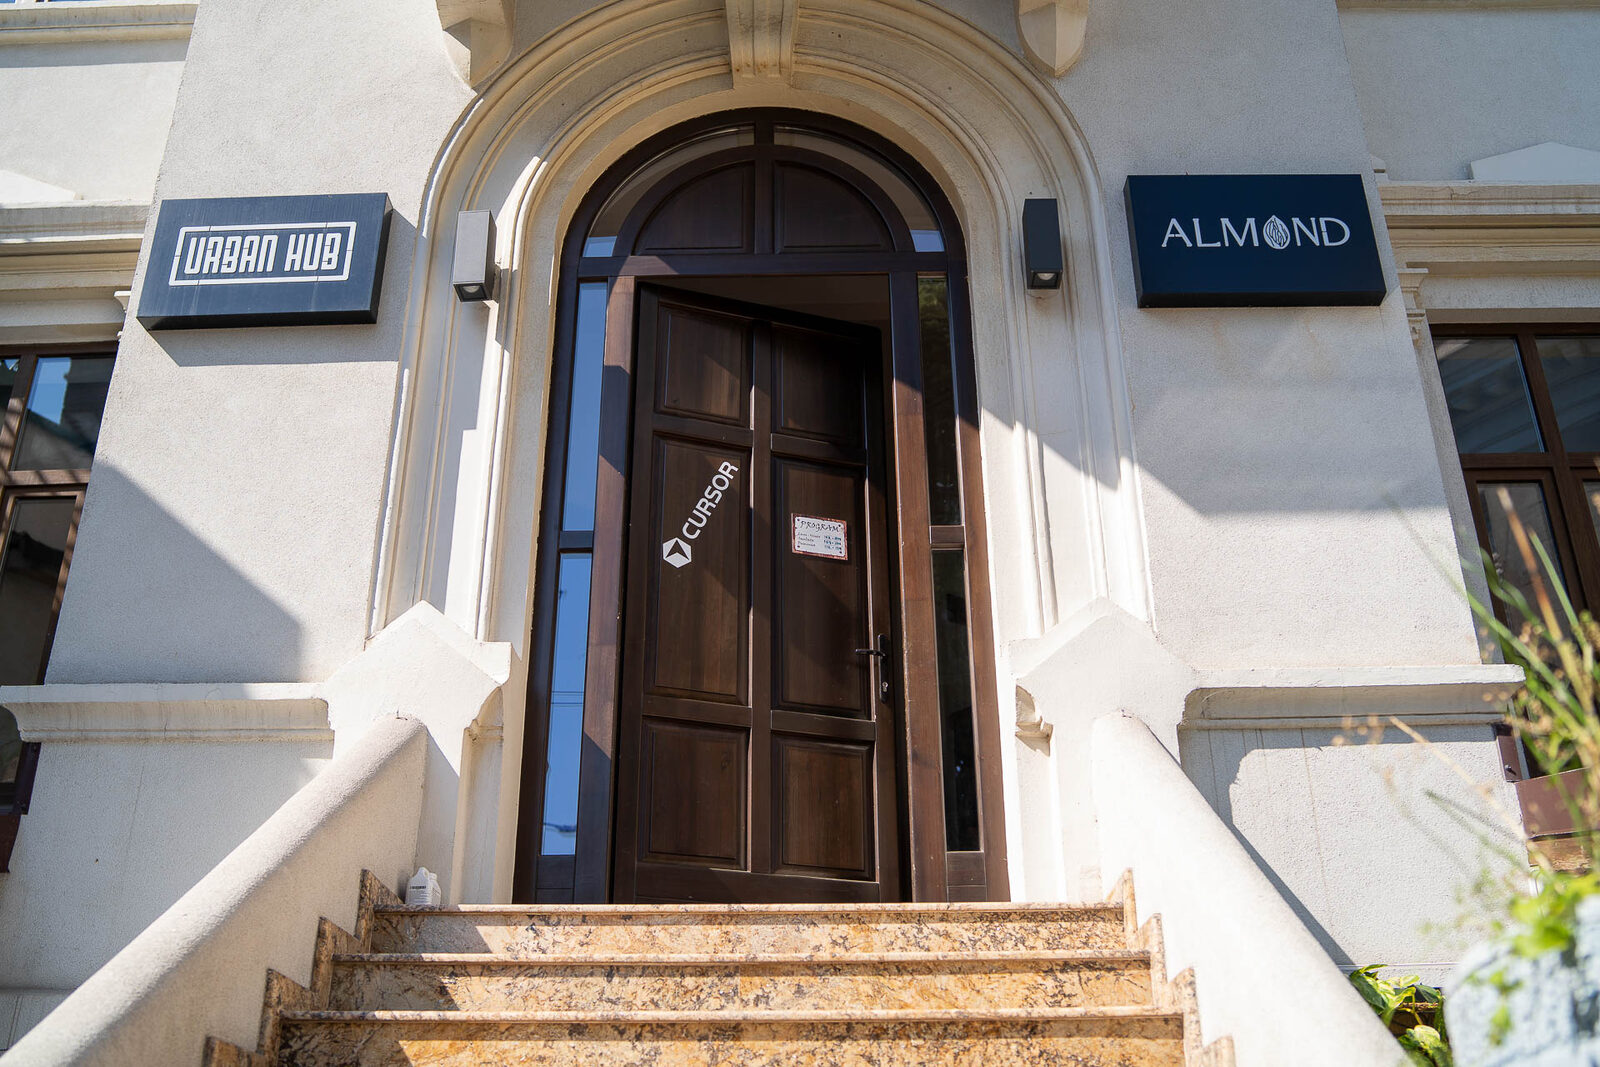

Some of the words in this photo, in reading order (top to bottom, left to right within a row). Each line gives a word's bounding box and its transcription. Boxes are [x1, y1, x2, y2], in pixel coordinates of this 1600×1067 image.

[1161, 215, 1351, 250] ALMOND
[184, 234, 279, 274] URBAN
[284, 232, 342, 272] HUB
[681, 461, 739, 540] CURSOR
[800, 520, 840, 532] PROGRAM
